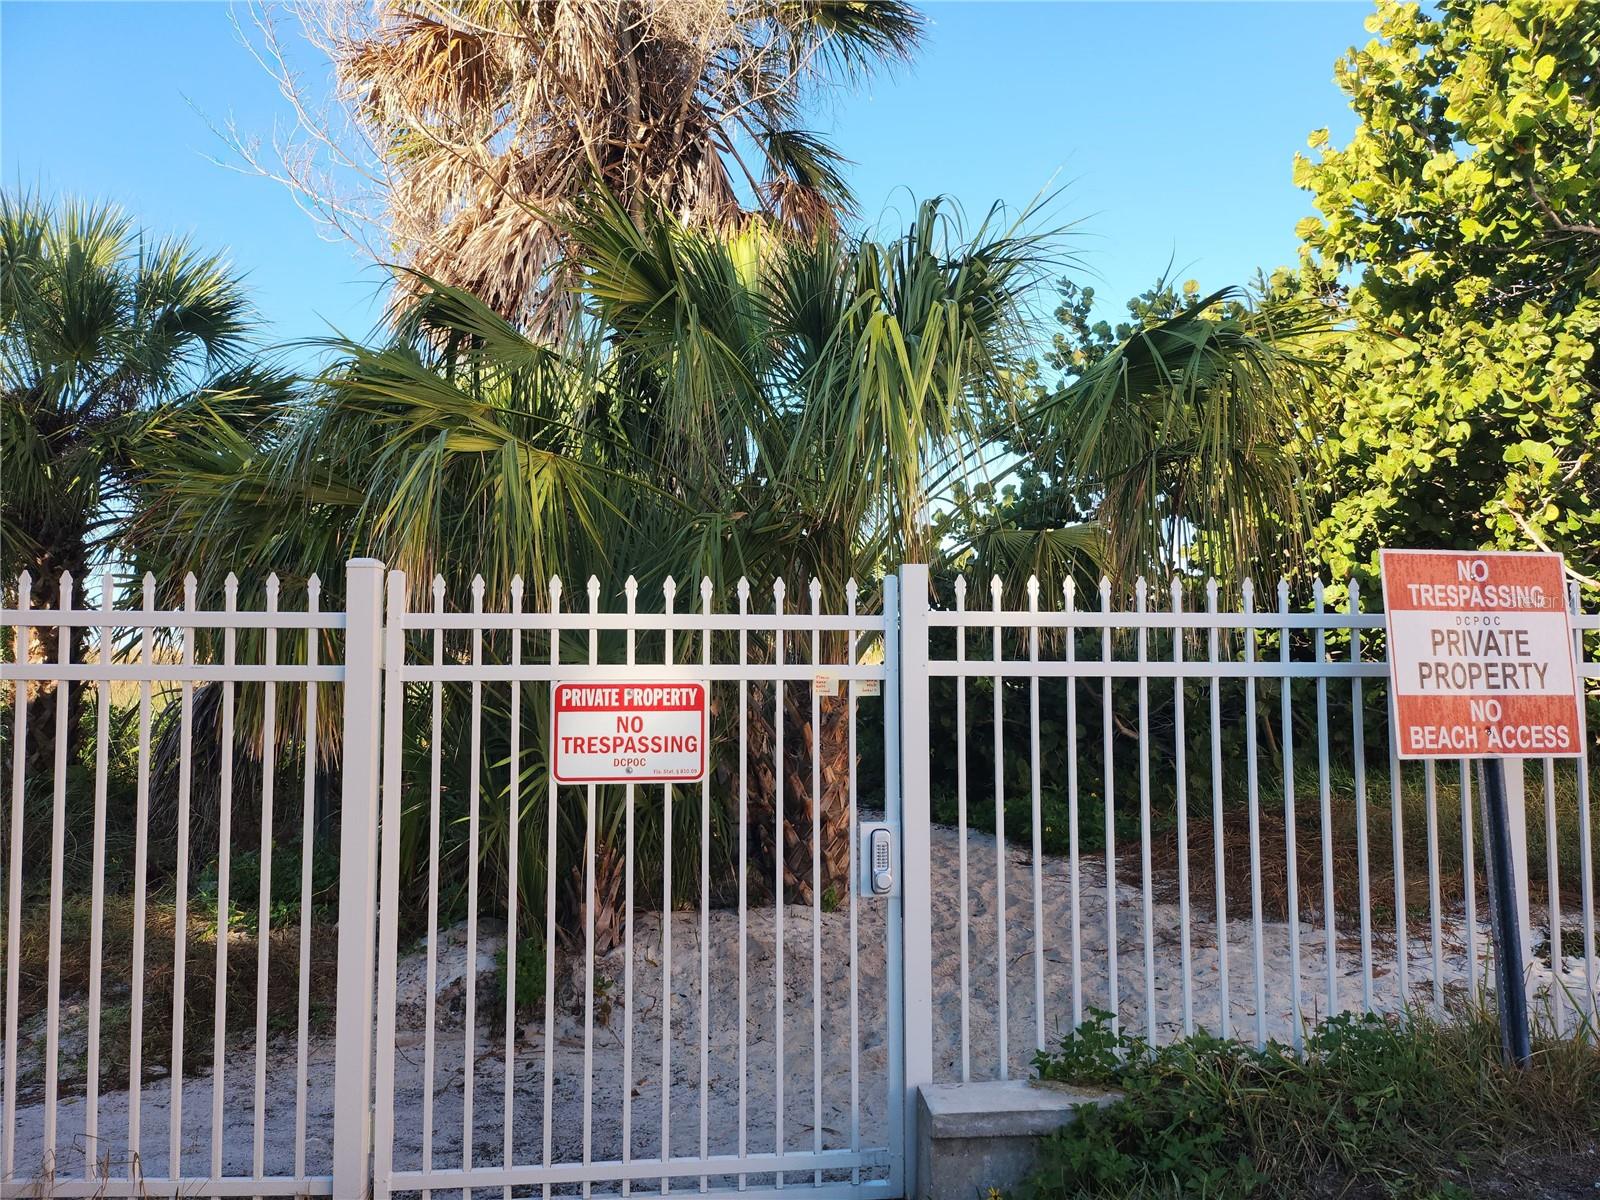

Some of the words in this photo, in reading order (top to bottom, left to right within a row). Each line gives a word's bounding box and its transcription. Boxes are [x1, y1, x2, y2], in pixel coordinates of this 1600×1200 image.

[1456, 559, 1489, 583] NO
[1407, 584, 1545, 607] TRESPASSING
[1455, 616, 1501, 626] DCPOC
[1431, 629, 1531, 657] PRIVATE
[1418, 662, 1549, 690] PROPERTY
[561, 688, 619, 707] PRIVATE
[624, 687, 698, 707] PROPERTY
[1470, 699, 1502, 722] NO
[616, 715, 644, 733] NO
[562, 736, 697, 754] TRESPASSING
[1409, 725, 1478, 749] BEACH
[1487, 725, 1570, 748] ACCESS
[613, 758, 646, 767] DCPOC
